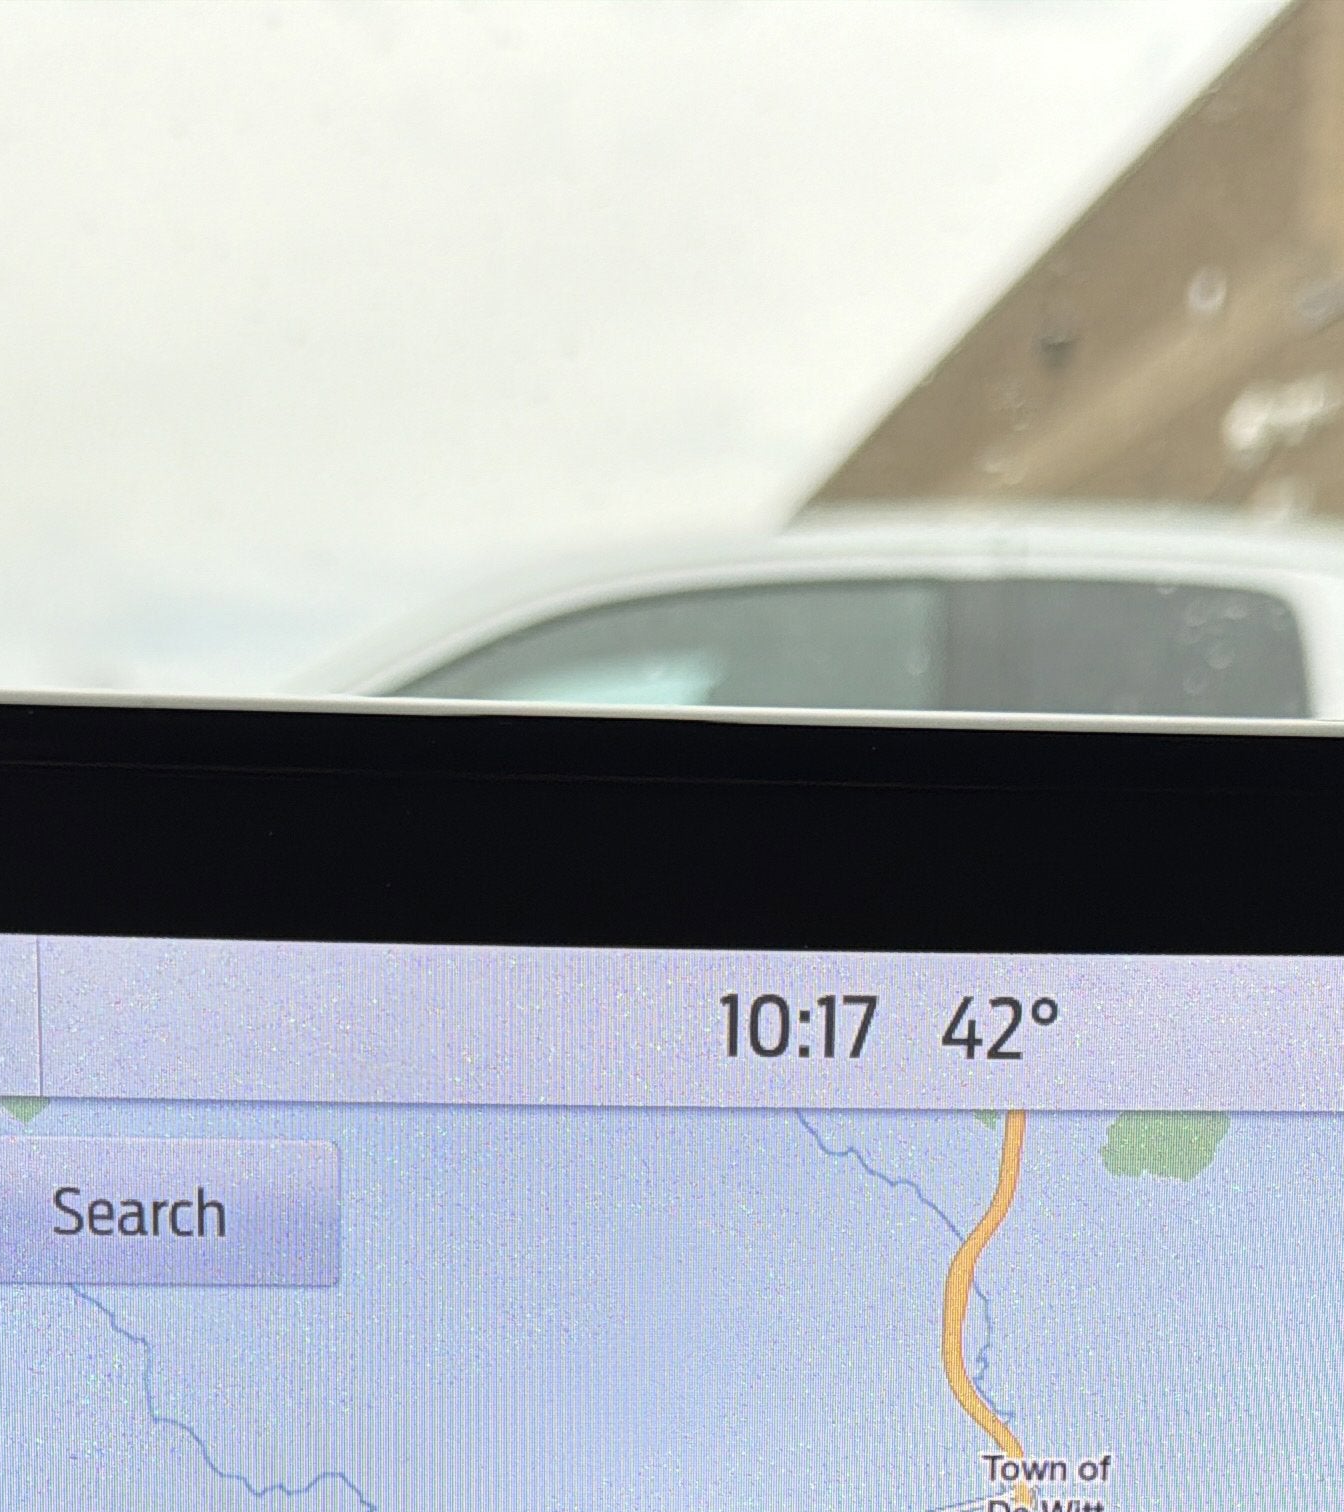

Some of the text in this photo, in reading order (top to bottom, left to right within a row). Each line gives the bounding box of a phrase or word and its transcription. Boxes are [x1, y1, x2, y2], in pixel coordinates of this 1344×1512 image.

[719, 993, 1059, 1060] 10:17 42°
[52, 1186, 227, 1238] Search
[981, 1454, 1112, 1482] Town of
